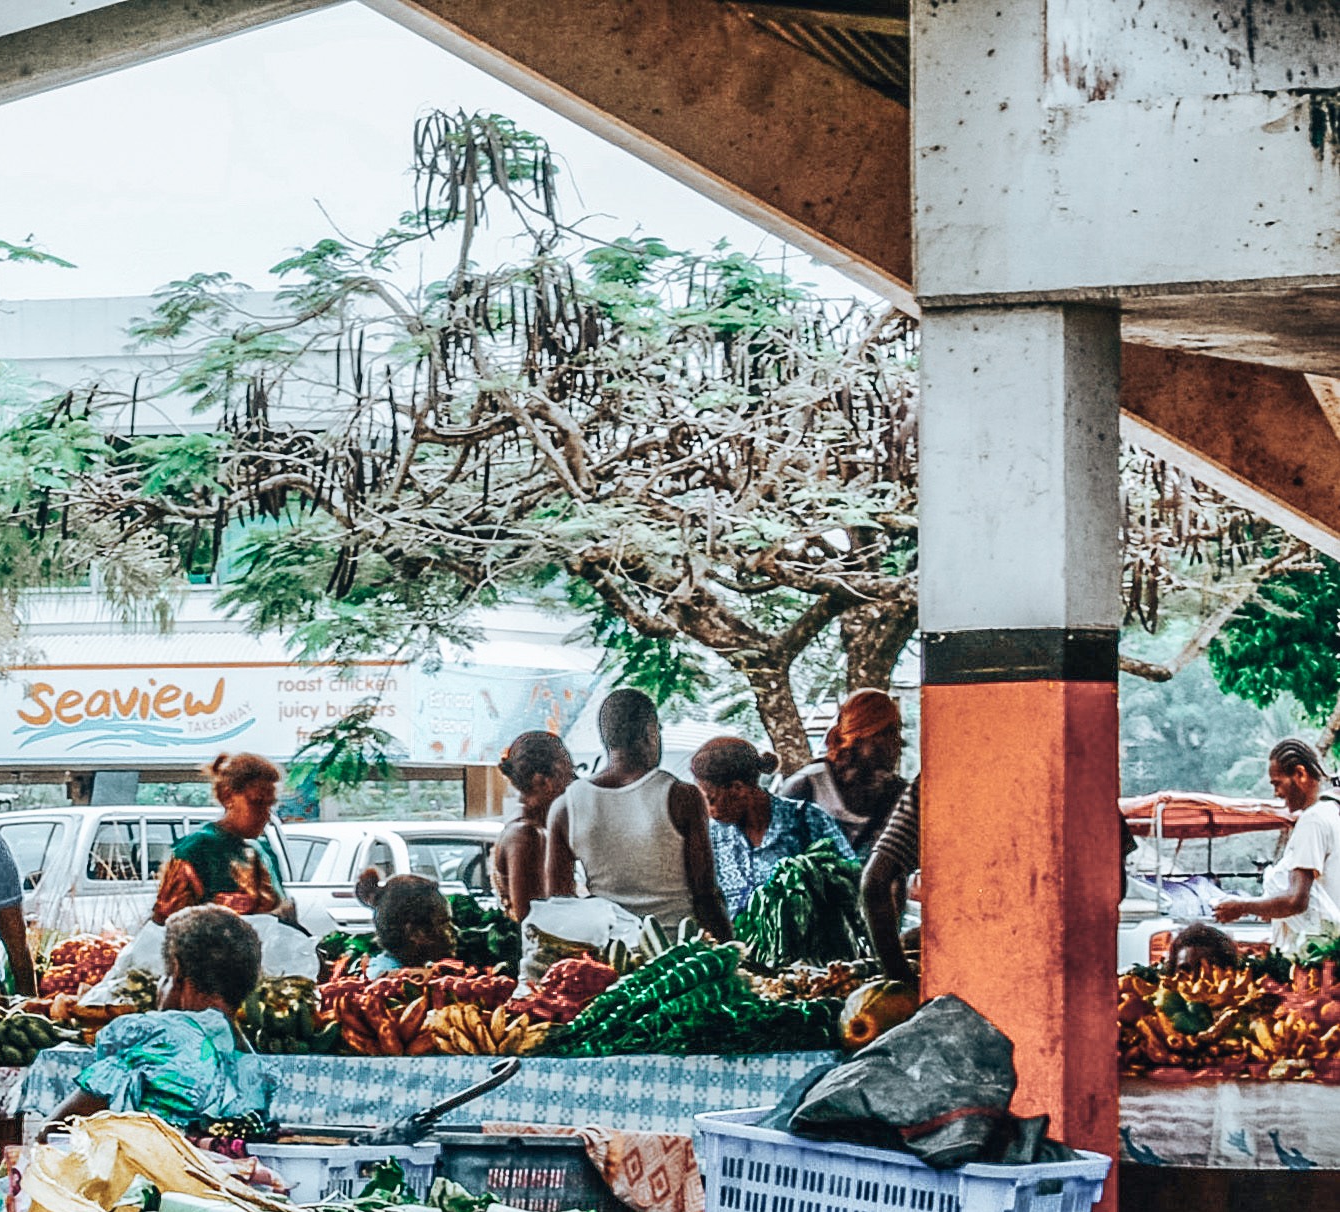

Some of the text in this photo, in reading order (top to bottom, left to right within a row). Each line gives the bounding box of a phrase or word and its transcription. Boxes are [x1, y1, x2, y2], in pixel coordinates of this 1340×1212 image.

[278, 677, 398, 692] roast chicken
[16, 677, 225, 725] Seaview
[279, 702, 318, 722] juicy
[187, 701, 253, 733] TAKEAWAY
